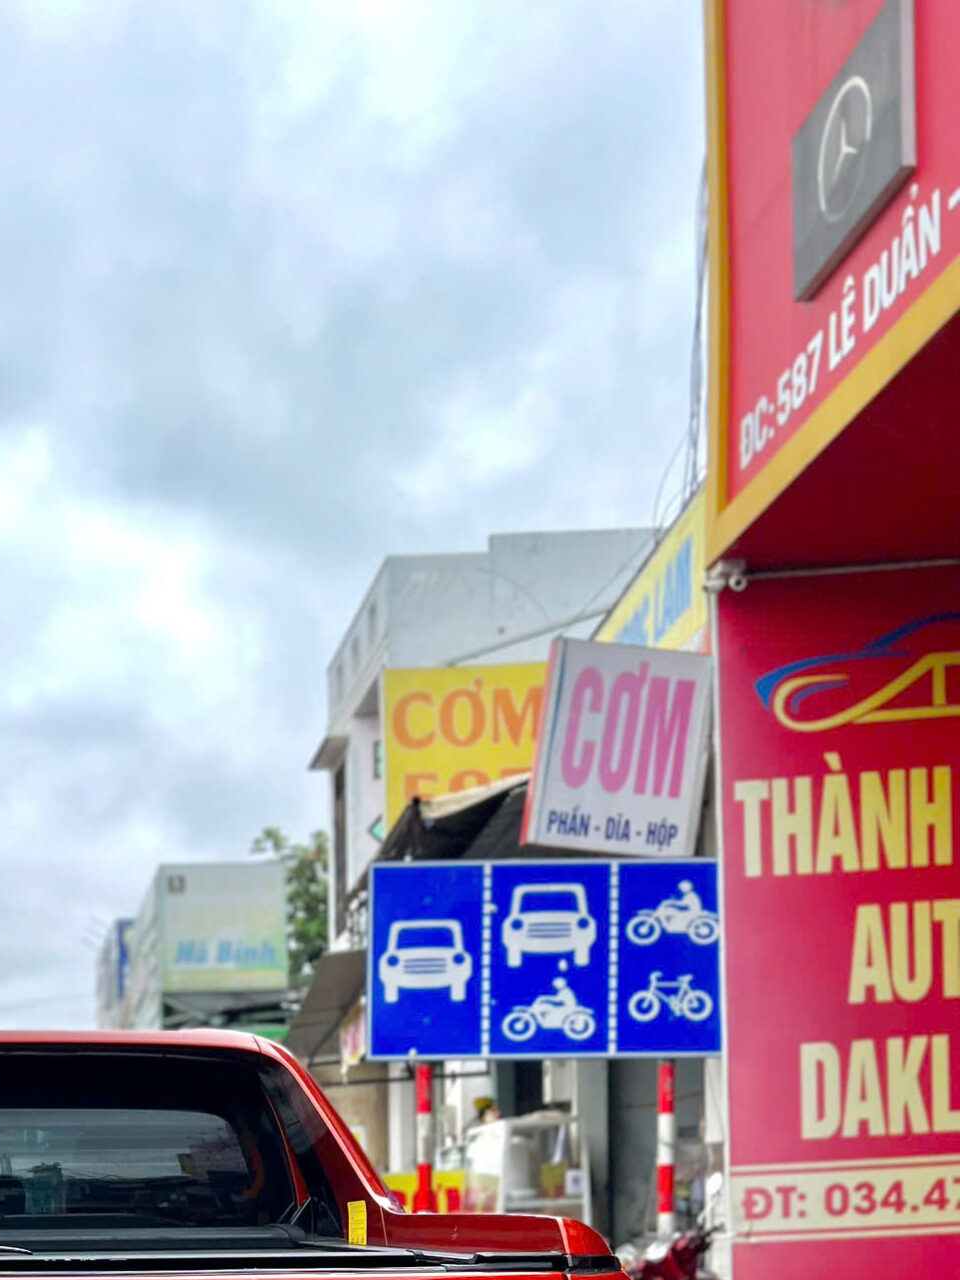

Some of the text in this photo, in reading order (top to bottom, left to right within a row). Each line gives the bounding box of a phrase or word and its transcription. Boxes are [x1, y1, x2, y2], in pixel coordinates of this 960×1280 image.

[776, 328, 824, 427] 587
[829, 274, 856, 372] LÊ
[392, 678, 548, 749] CƠM
[561, 661, 697, 800] CƠM
[733, 751, 953, 878] THÀNH
[848, 898, 960, 1005] AUT
[799, 1033, 960, 1141] DAKL
[742, 1185, 807, 1220] ĐT:
